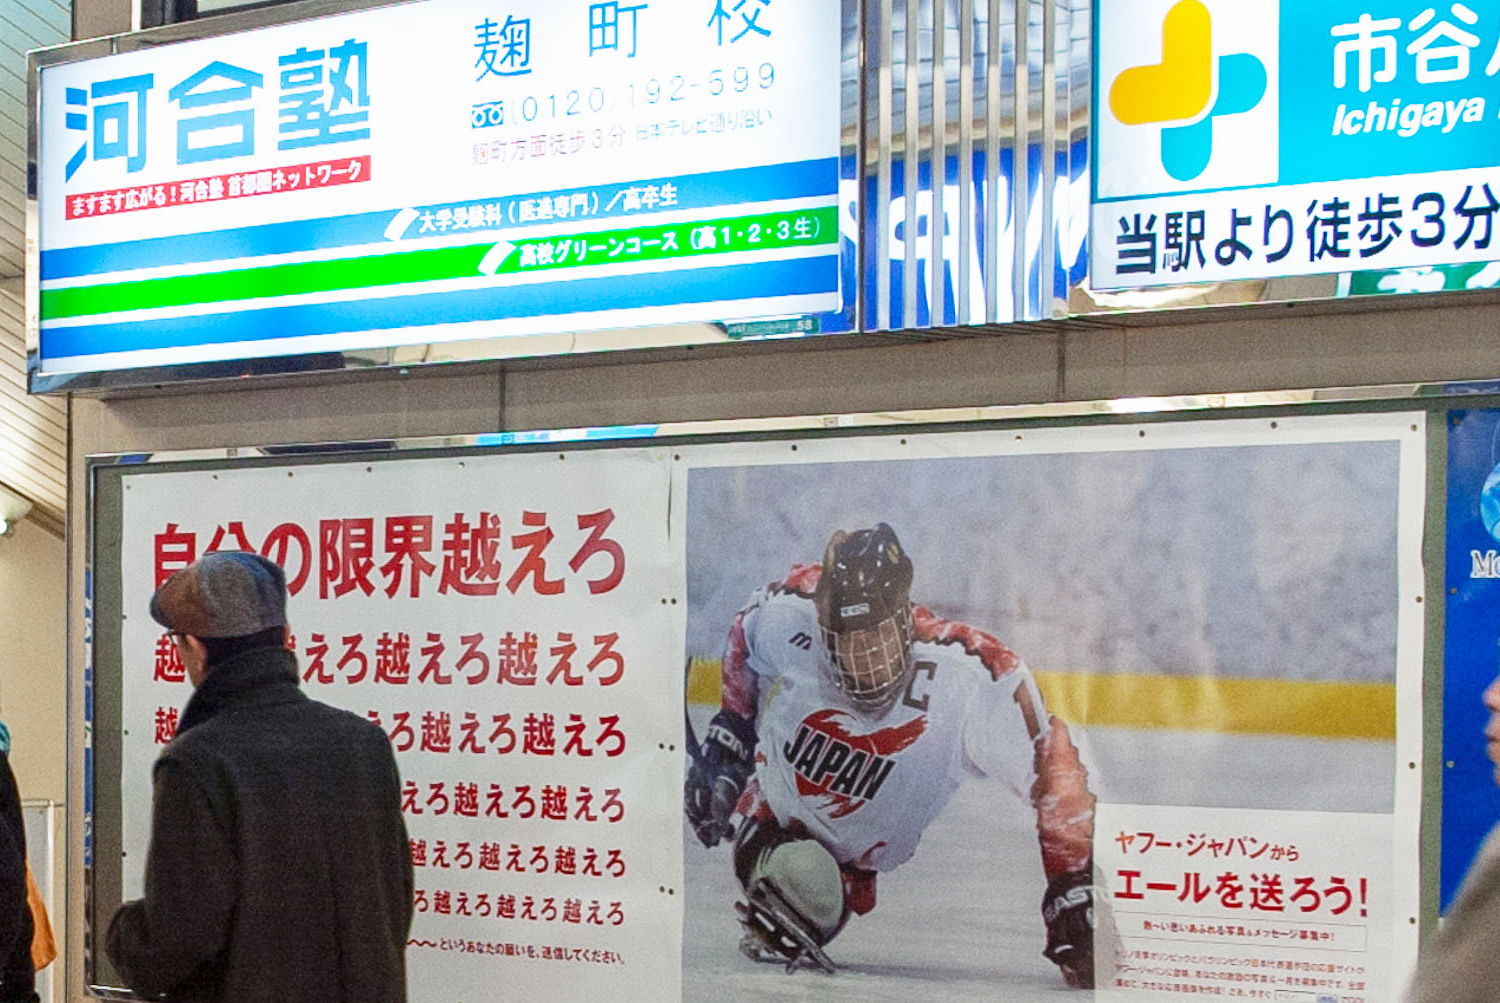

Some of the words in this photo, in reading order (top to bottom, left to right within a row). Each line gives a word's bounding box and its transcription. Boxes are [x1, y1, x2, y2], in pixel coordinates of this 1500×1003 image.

[65, 38, 371, 184] 河合塾
[1332, 97, 1486, 137] Ichigaya
[1115, 182, 1500, 275] 当駅より徒歩3分
[783, 726, 897, 801] JAPAN
[1115, 830, 1300, 862] ヤフー・ジャパンから
[1114, 870, 1368, 918] エールを送ろう!
